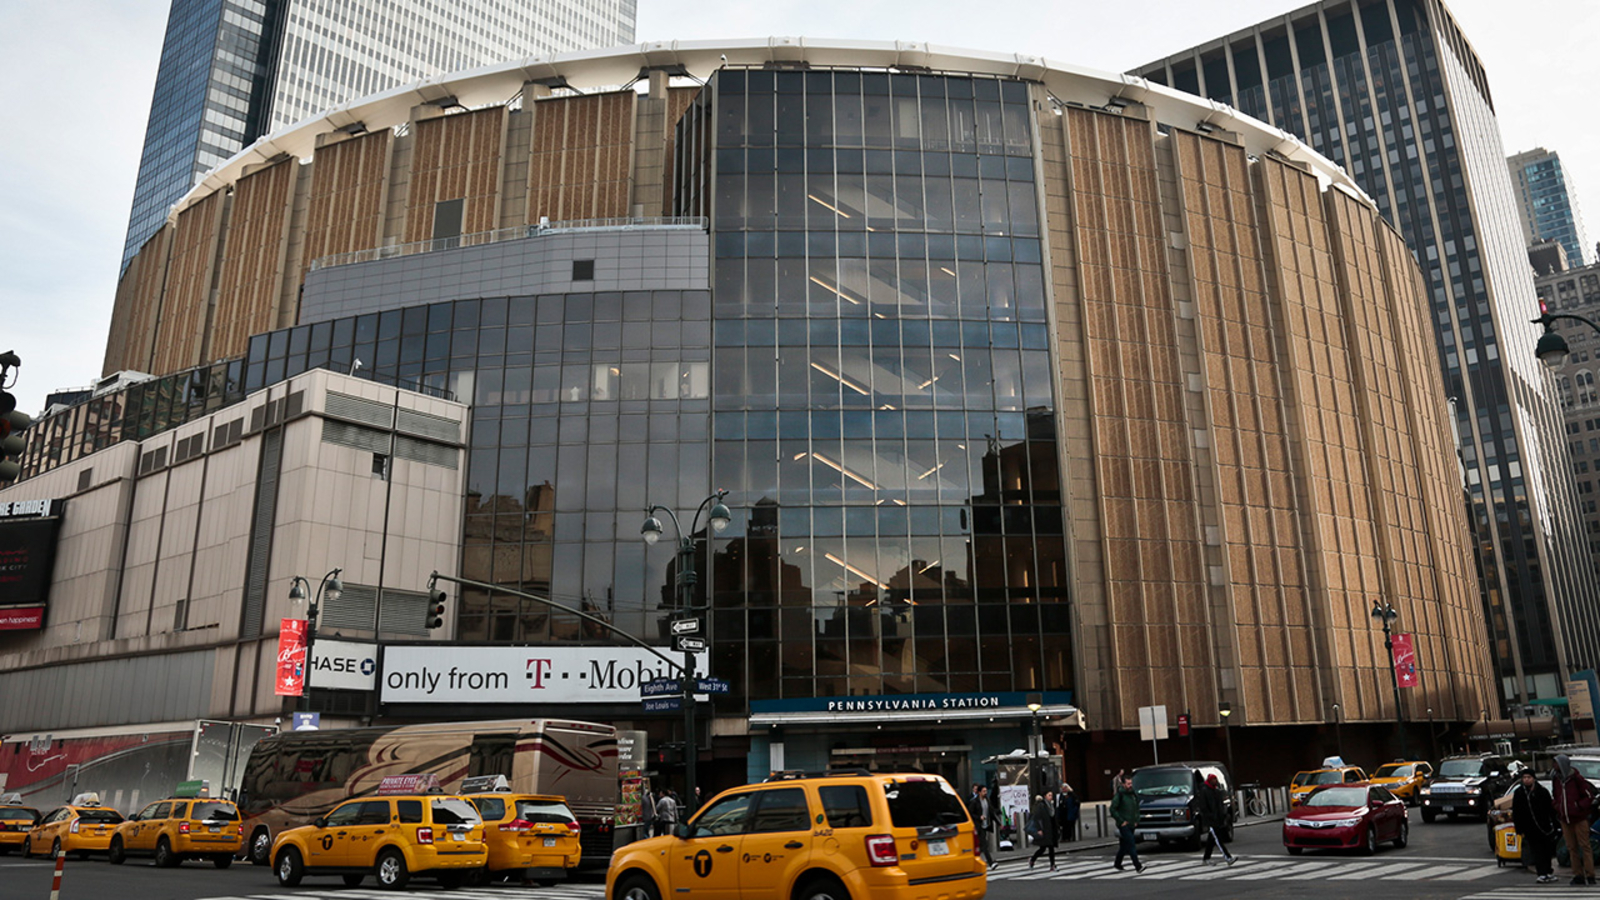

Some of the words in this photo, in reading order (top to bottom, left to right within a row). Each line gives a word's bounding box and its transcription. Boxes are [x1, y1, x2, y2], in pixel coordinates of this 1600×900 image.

[12, 499, 51, 516] GARDEN
[311, 656, 357, 673] HASE
[387, 667, 441, 694] only
[448, 668, 508, 689] from
[699, 683, 712, 691] West
[644, 684, 664, 694] Eighth
[665, 683, 678, 691] Ave
[645, 702, 655, 710] Joe
[655, 700, 670, 709] Louis
[828, 699, 936, 711] PENNSYLVANIA
[942, 696, 999, 708] STATION
